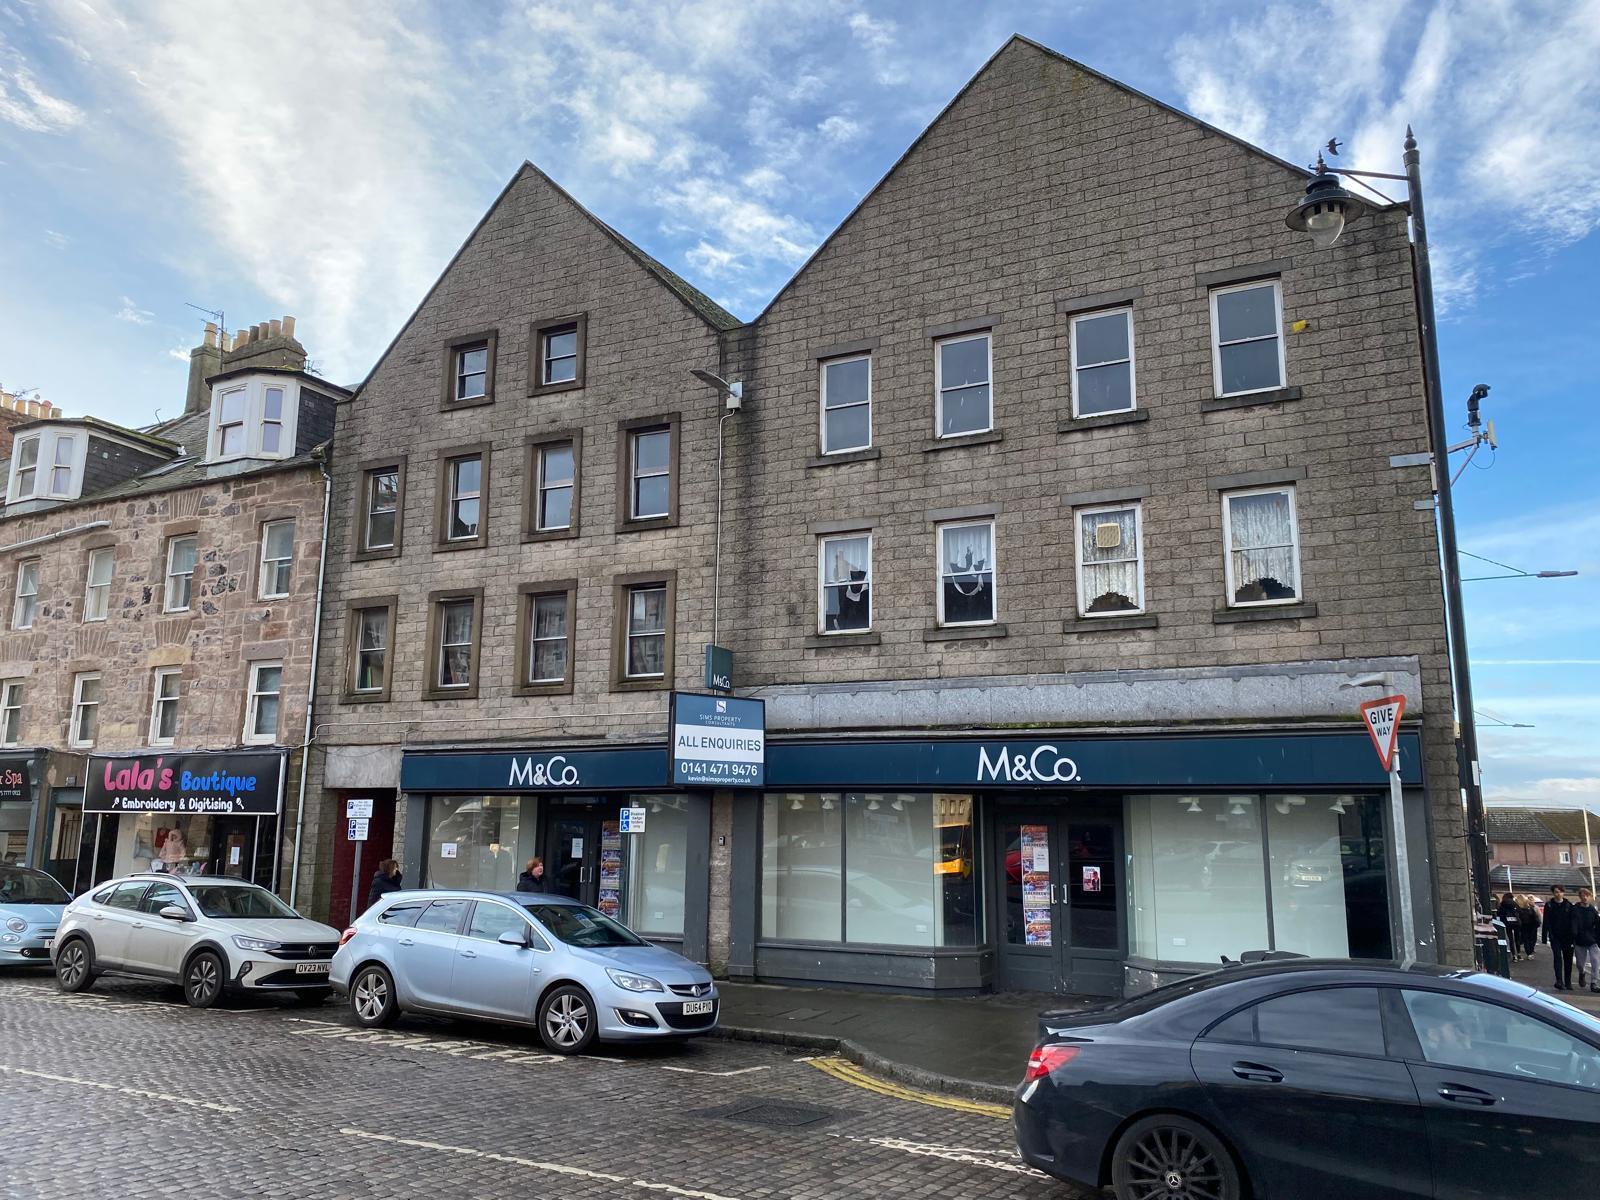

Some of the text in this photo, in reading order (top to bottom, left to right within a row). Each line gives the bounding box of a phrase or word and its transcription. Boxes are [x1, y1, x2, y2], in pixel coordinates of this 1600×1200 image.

[713, 715, 742, 723] PROPERTY
[1370, 708, 1393, 724] GIVE
[1376, 726, 1391, 737] WAY
[678, 735, 761, 752] ALL ENQUIRIES
[508, 755, 580, 786] M&Co.
[681, 762, 758, 776] 0141 471 9476
[977, 744, 1082, 782] M&Co.
[5, 768, 23, 788] Spa
[104, 757, 257, 797] Lala's Boutique
[121, 797, 233, 813] Embroidery & Digitising
